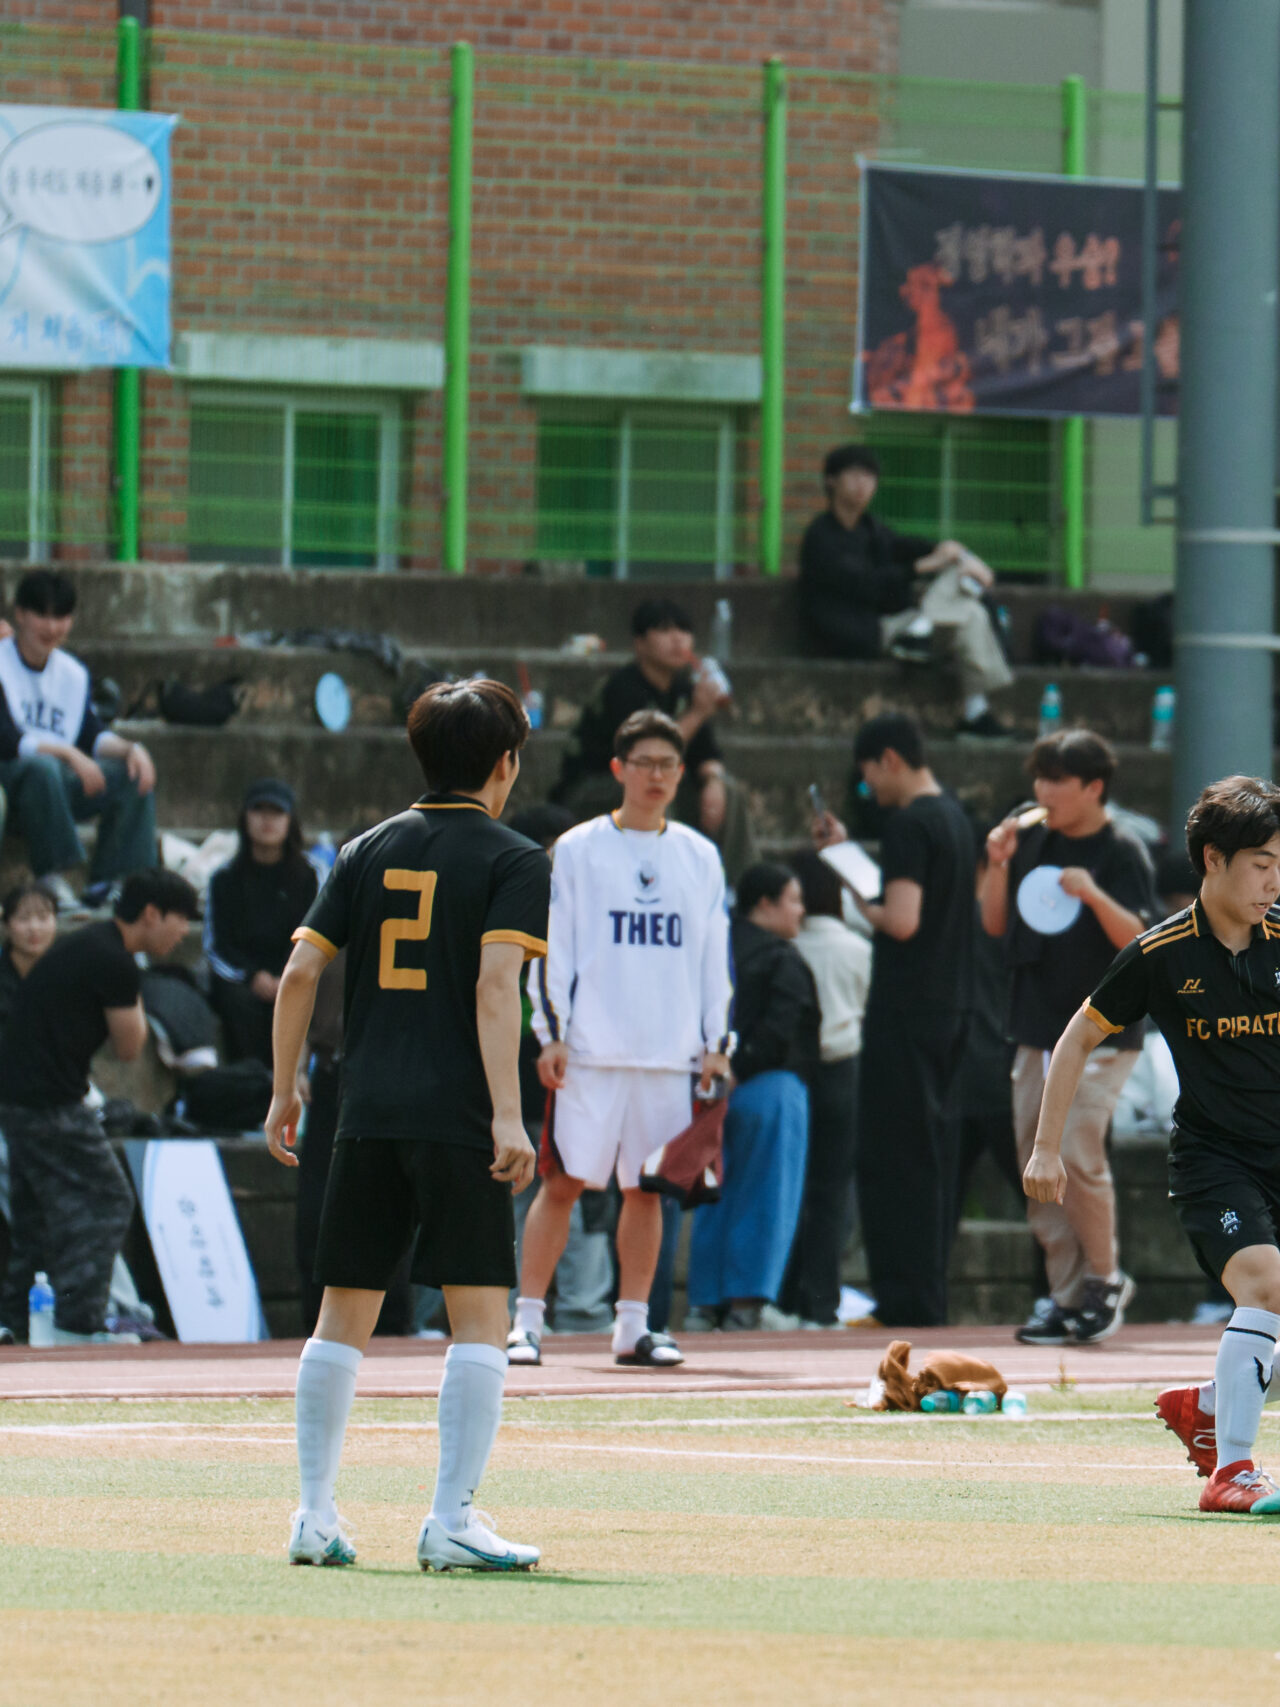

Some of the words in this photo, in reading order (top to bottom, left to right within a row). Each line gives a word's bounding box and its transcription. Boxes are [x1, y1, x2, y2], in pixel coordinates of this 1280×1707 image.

[378, 868, 438, 990] 2
[608, 909, 683, 948] THEO
[1185, 1017, 1211, 1040] FC
